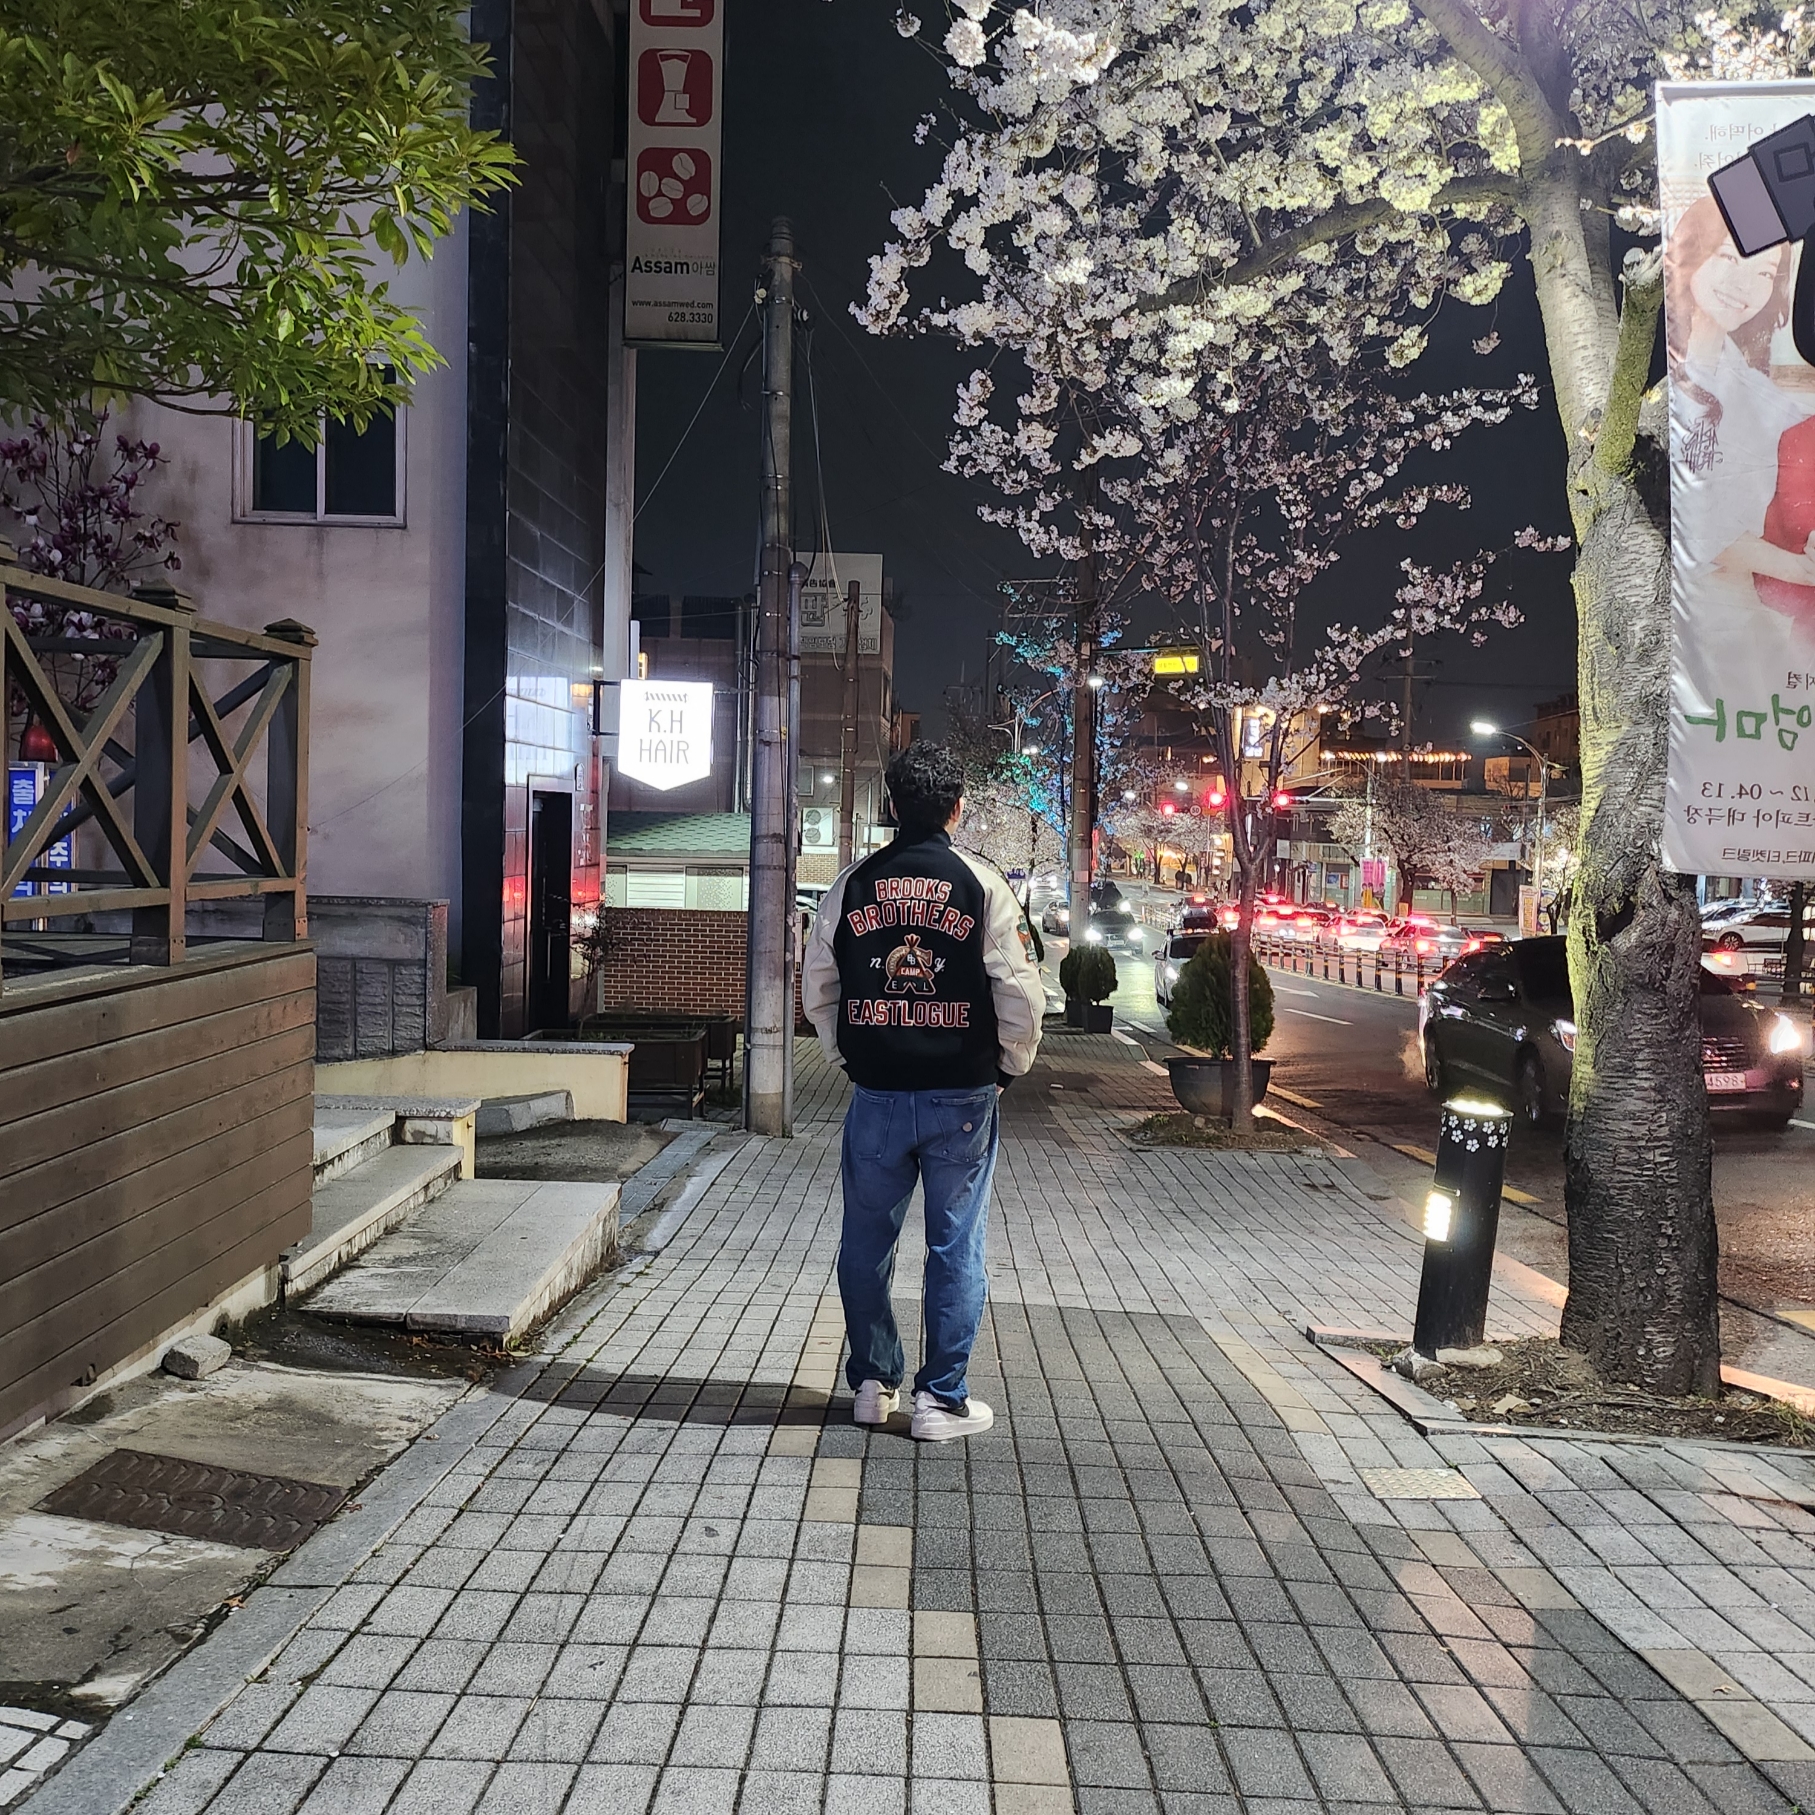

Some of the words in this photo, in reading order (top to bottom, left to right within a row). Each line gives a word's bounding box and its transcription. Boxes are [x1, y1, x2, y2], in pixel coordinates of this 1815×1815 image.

[631, 255, 690, 275] Assam
[667, 311, 714, 324] 628.3330
[647, 708, 684, 734] K.H
[639, 738, 690, 764] HAIR
[874, 876, 952, 903] BROOKS
[847, 899, 975, 942] BROTHERS
[900, 967, 921, 976] CAMP
[847, 999, 971, 1028] EASTLOGUE
